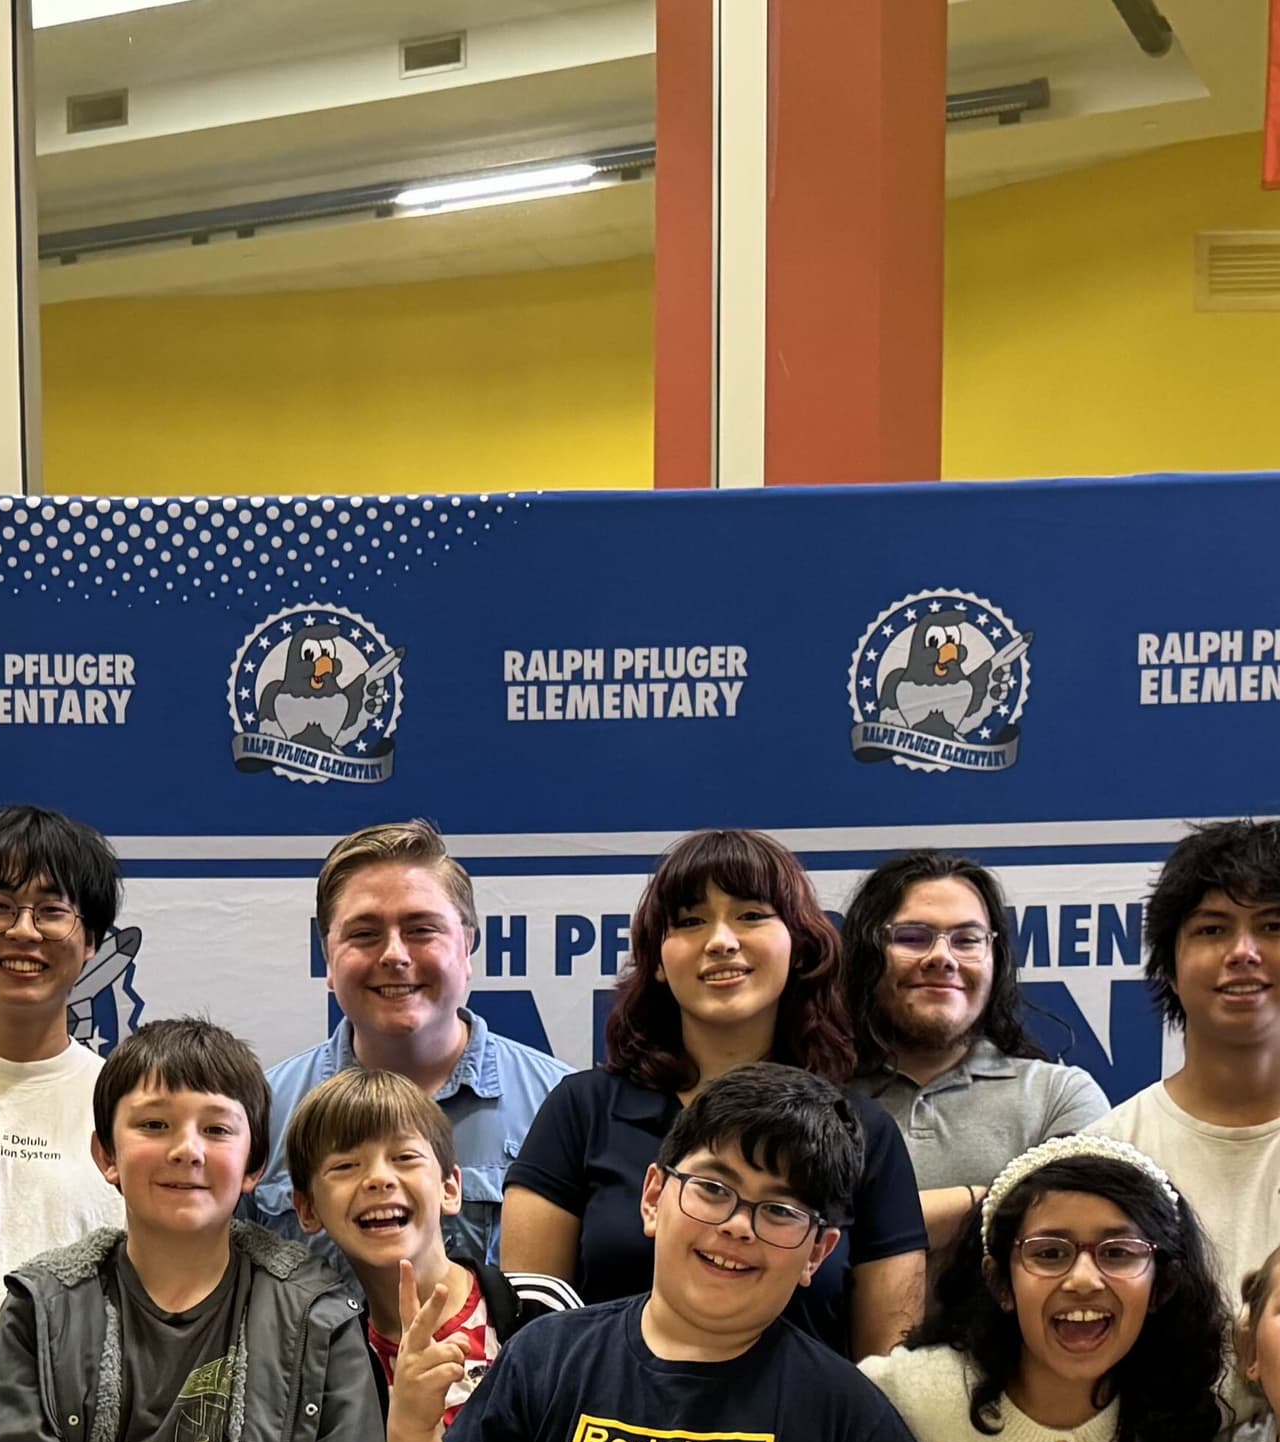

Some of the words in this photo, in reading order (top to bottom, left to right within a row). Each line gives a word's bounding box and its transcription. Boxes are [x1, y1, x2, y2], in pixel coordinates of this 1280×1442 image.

[504, 648, 604, 682] RALPH
[614, 645, 748, 679] PFLUGER
[1138, 630, 1243, 665] RALPH
[4, 653, 136, 685] PFLUGER
[507, 681, 744, 721] ELEMENTARY
[242, 736, 274, 753] RALPH
[276, 747, 317, 768] PFLUGER
[319, 758, 383, 779] ELEMENTARY
[862, 726, 896, 744] RALPH
[897, 735, 940, 757] PFLUGER
[941, 744, 1006, 767] ELEMENTARY
[11, 1134, 48, 1147] Delulu
[20, 1149, 61, 1162] System
